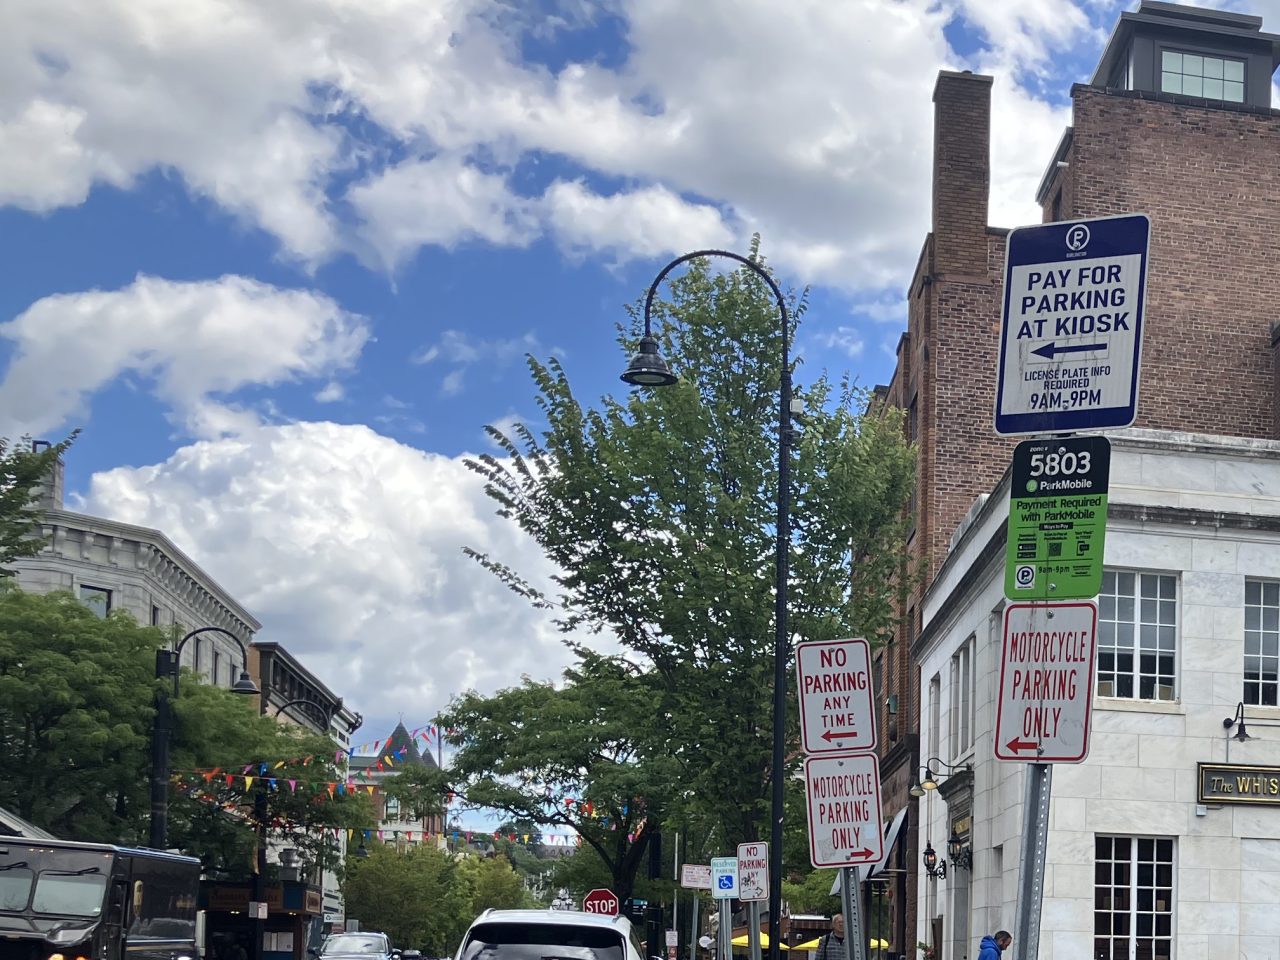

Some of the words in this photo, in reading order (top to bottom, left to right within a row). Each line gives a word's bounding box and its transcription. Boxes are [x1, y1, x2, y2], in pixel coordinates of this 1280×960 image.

[1028, 269, 1071, 291] PAY
[1078, 265, 1121, 287] FOR
[1021, 288, 1125, 314] PARKING
[1017, 319, 1047, 339] AT
[1055, 312, 1129, 336] KIOSK
[1024, 367, 1060, 381] LICENSE
[1062, 366, 1089, 379] PLATE
[1090, 366, 1111, 377] INFO
[1043, 378, 1089, 390] REQUIRED
[1030, 389, 1101, 409] 9AM-9PM
[1030, 451, 1091, 476] 5803
[1040, 479, 1093, 490] ParkMobile
[1016, 499, 1057, 512] Payment
[1060, 496, 1101, 509] Required
[1021, 511, 1041, 522] with
[1044, 509, 1095, 521] ParkMobile
[1010, 632, 1087, 663] MOTORCYCLE
[820, 648, 847, 668] NO
[805, 671, 867, 694] PARKING
[1012, 669, 1077, 700] PARKING
[824, 696, 851, 711] ANY
[821, 713, 856, 728] TIME
[1023, 707, 1061, 738] ONLY
[813, 773, 873, 799] MOTORCYCLE
[1211, 776, 1233, 793] The
[819, 799, 869, 825] PARKING
[832, 827, 861, 850] ONLY
[746, 847, 758, 857] NO
[740, 859, 766, 871] PARKING
[586, 900, 616, 913] STOP
